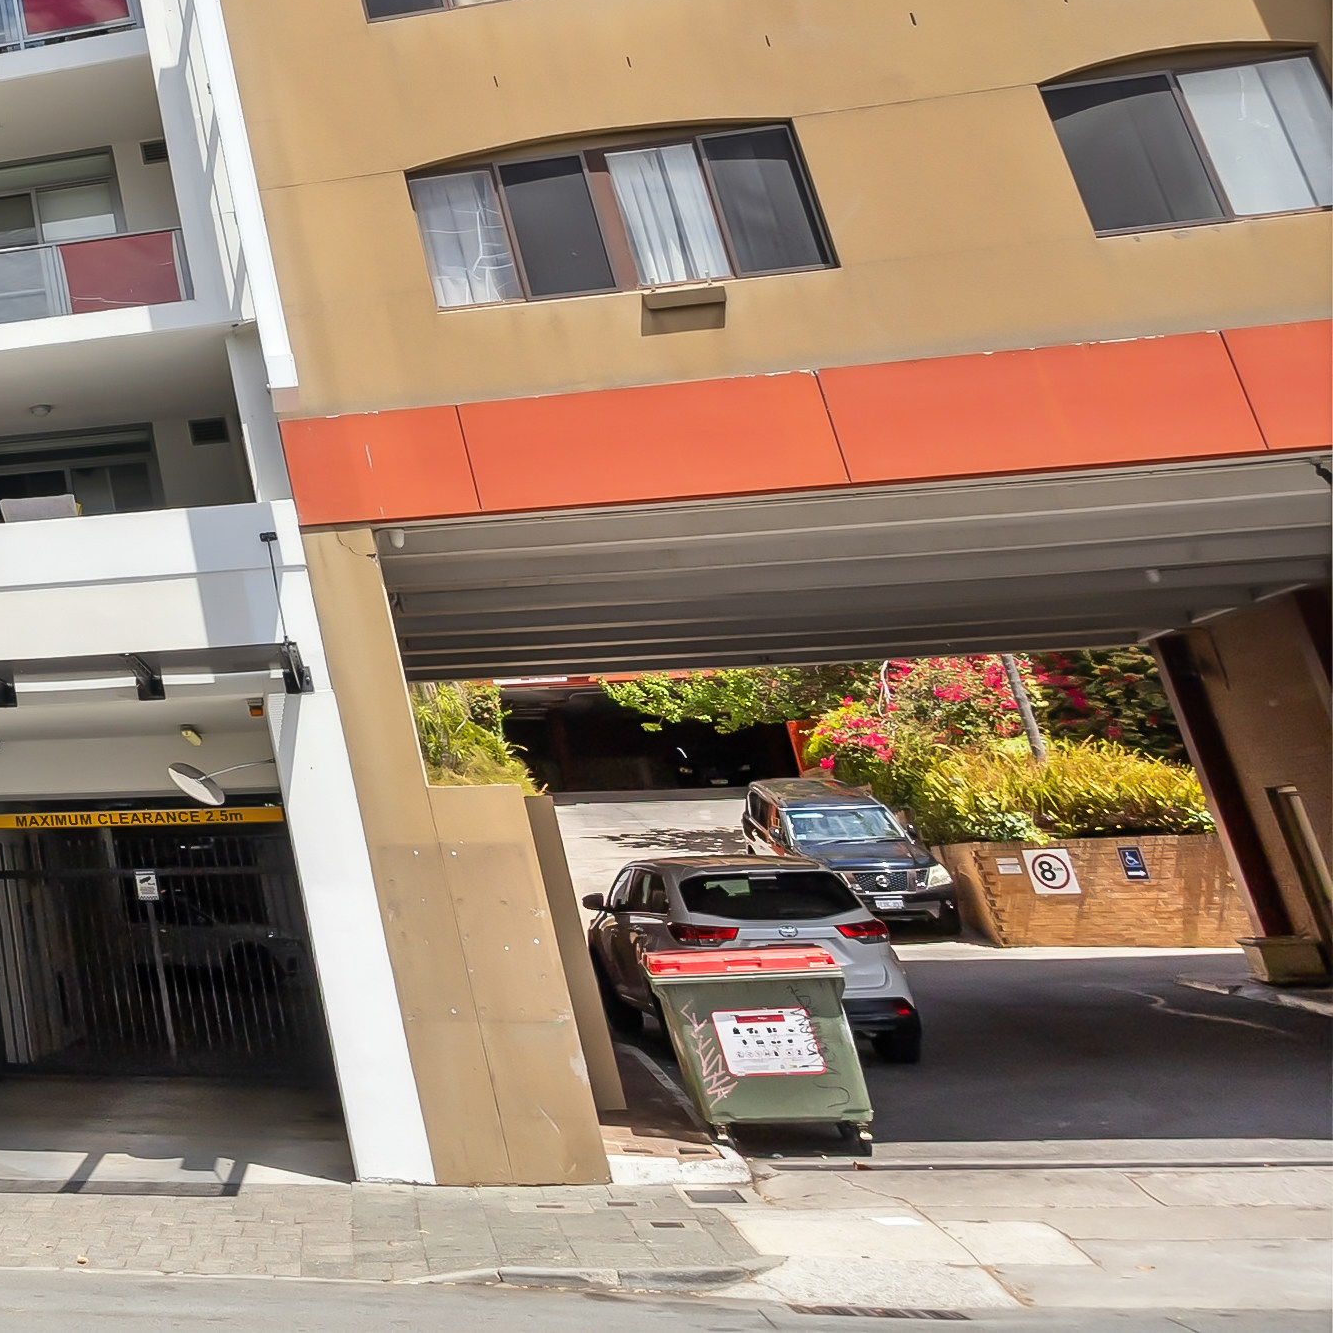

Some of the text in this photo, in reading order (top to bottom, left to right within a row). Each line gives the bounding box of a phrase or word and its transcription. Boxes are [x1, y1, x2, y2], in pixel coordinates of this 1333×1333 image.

[15, 810, 244, 827] MAXIMUM CLEARANCE 2.5m
[1038, 860, 1057, 882] 8
